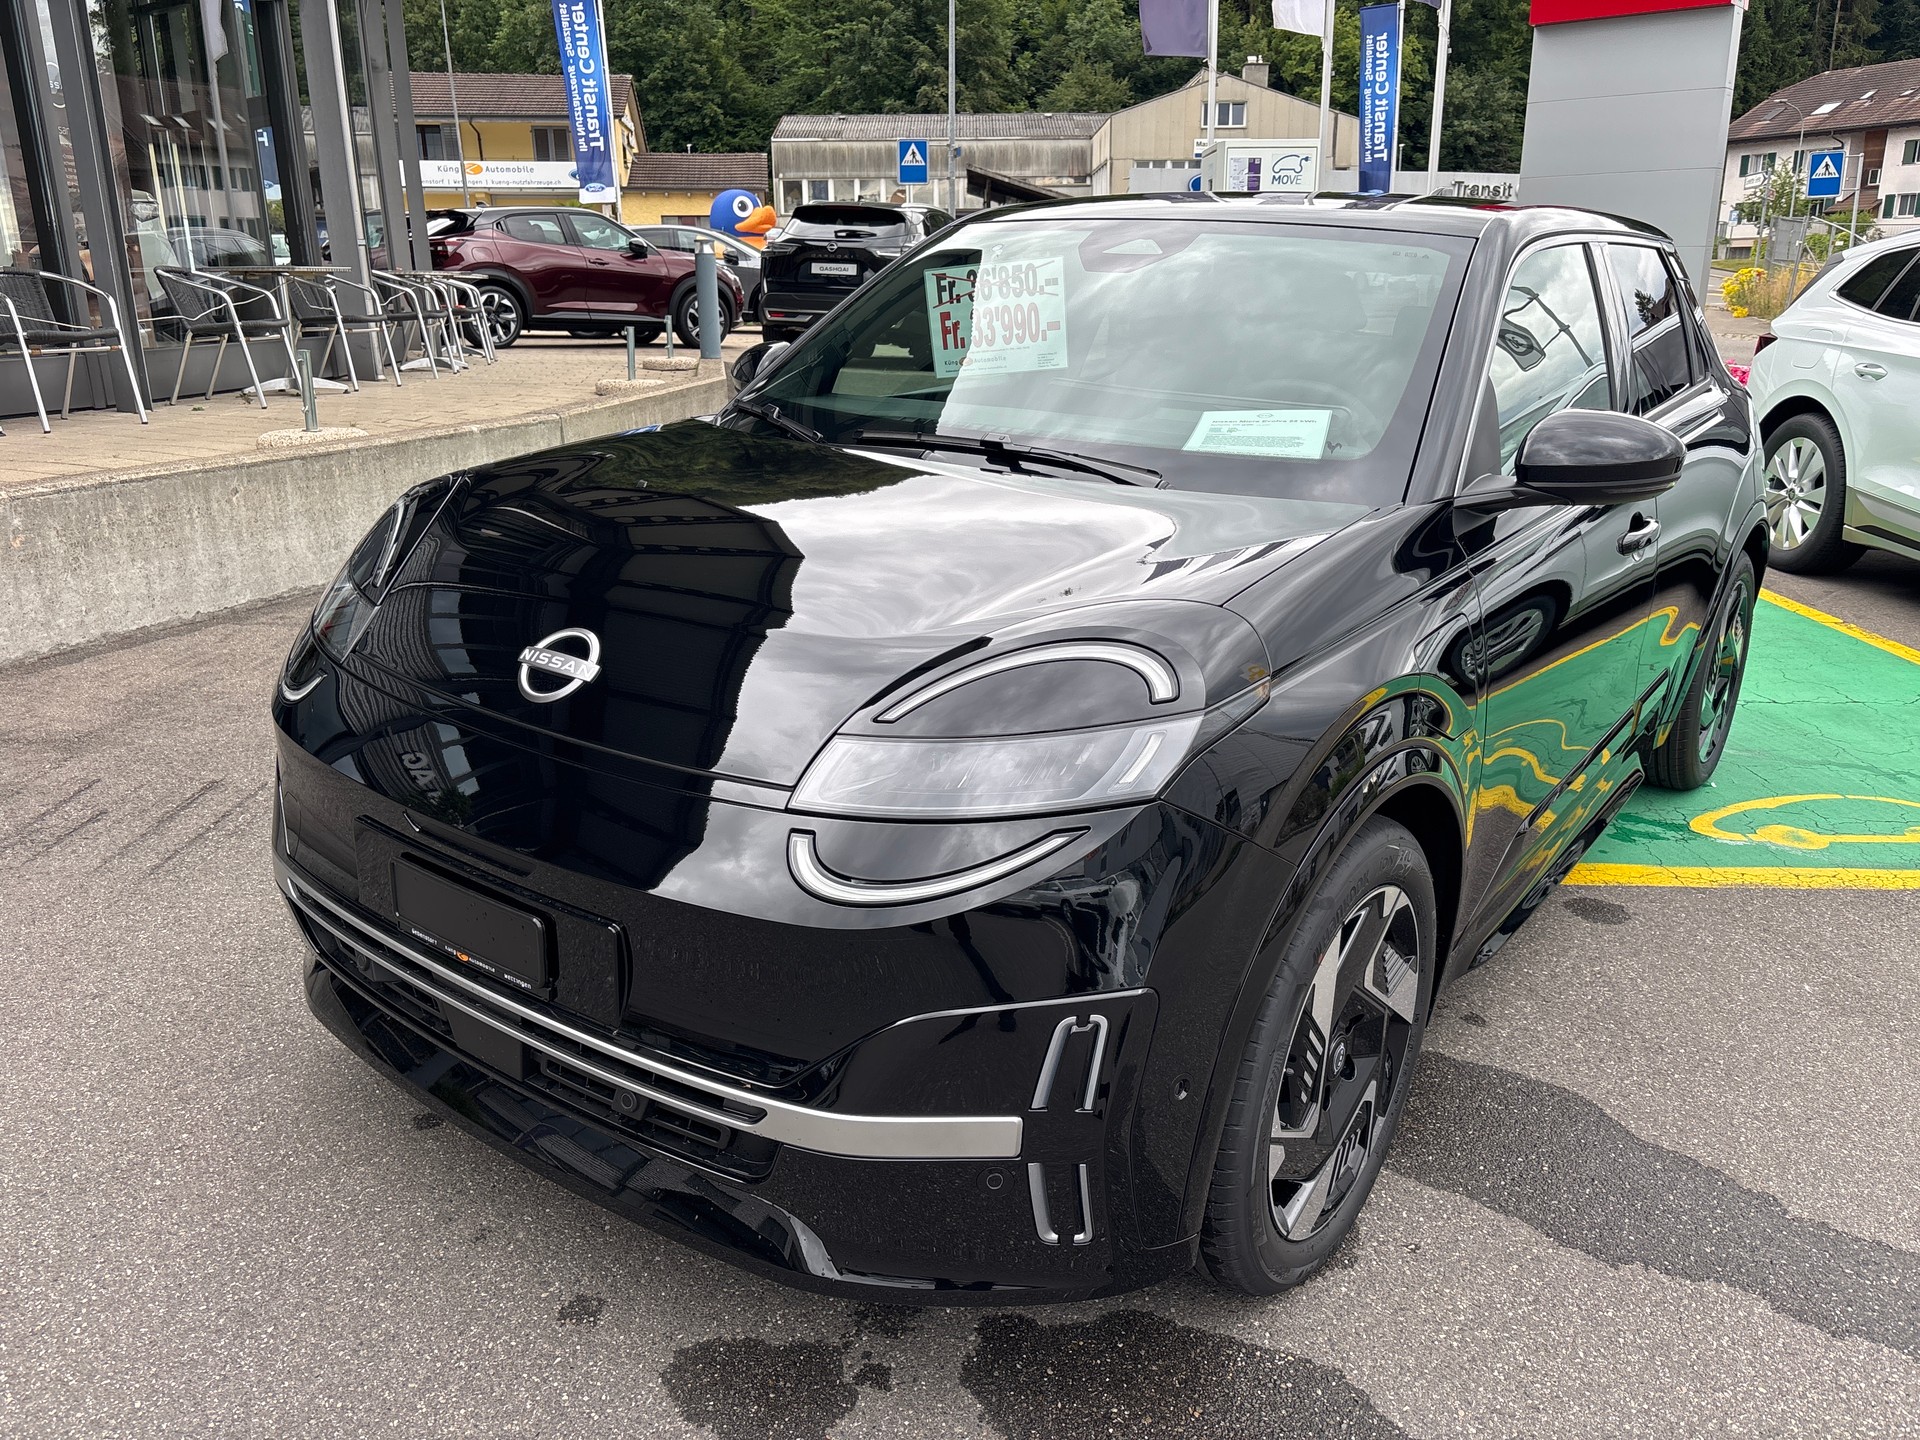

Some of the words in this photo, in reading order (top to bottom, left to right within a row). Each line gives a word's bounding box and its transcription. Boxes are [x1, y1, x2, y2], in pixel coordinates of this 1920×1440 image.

[437, 165, 460, 174] Küng
[485, 165, 535, 174] Automobile
[1271, 174, 1302, 185] MOVE
[1453, 180, 1513, 198] Transit
[819, 265, 849, 273] QASHQAI
[935, 273, 961, 305] Fr.
[940, 311, 966, 350] Fr.
[520, 648, 595, 678] NISSAN
